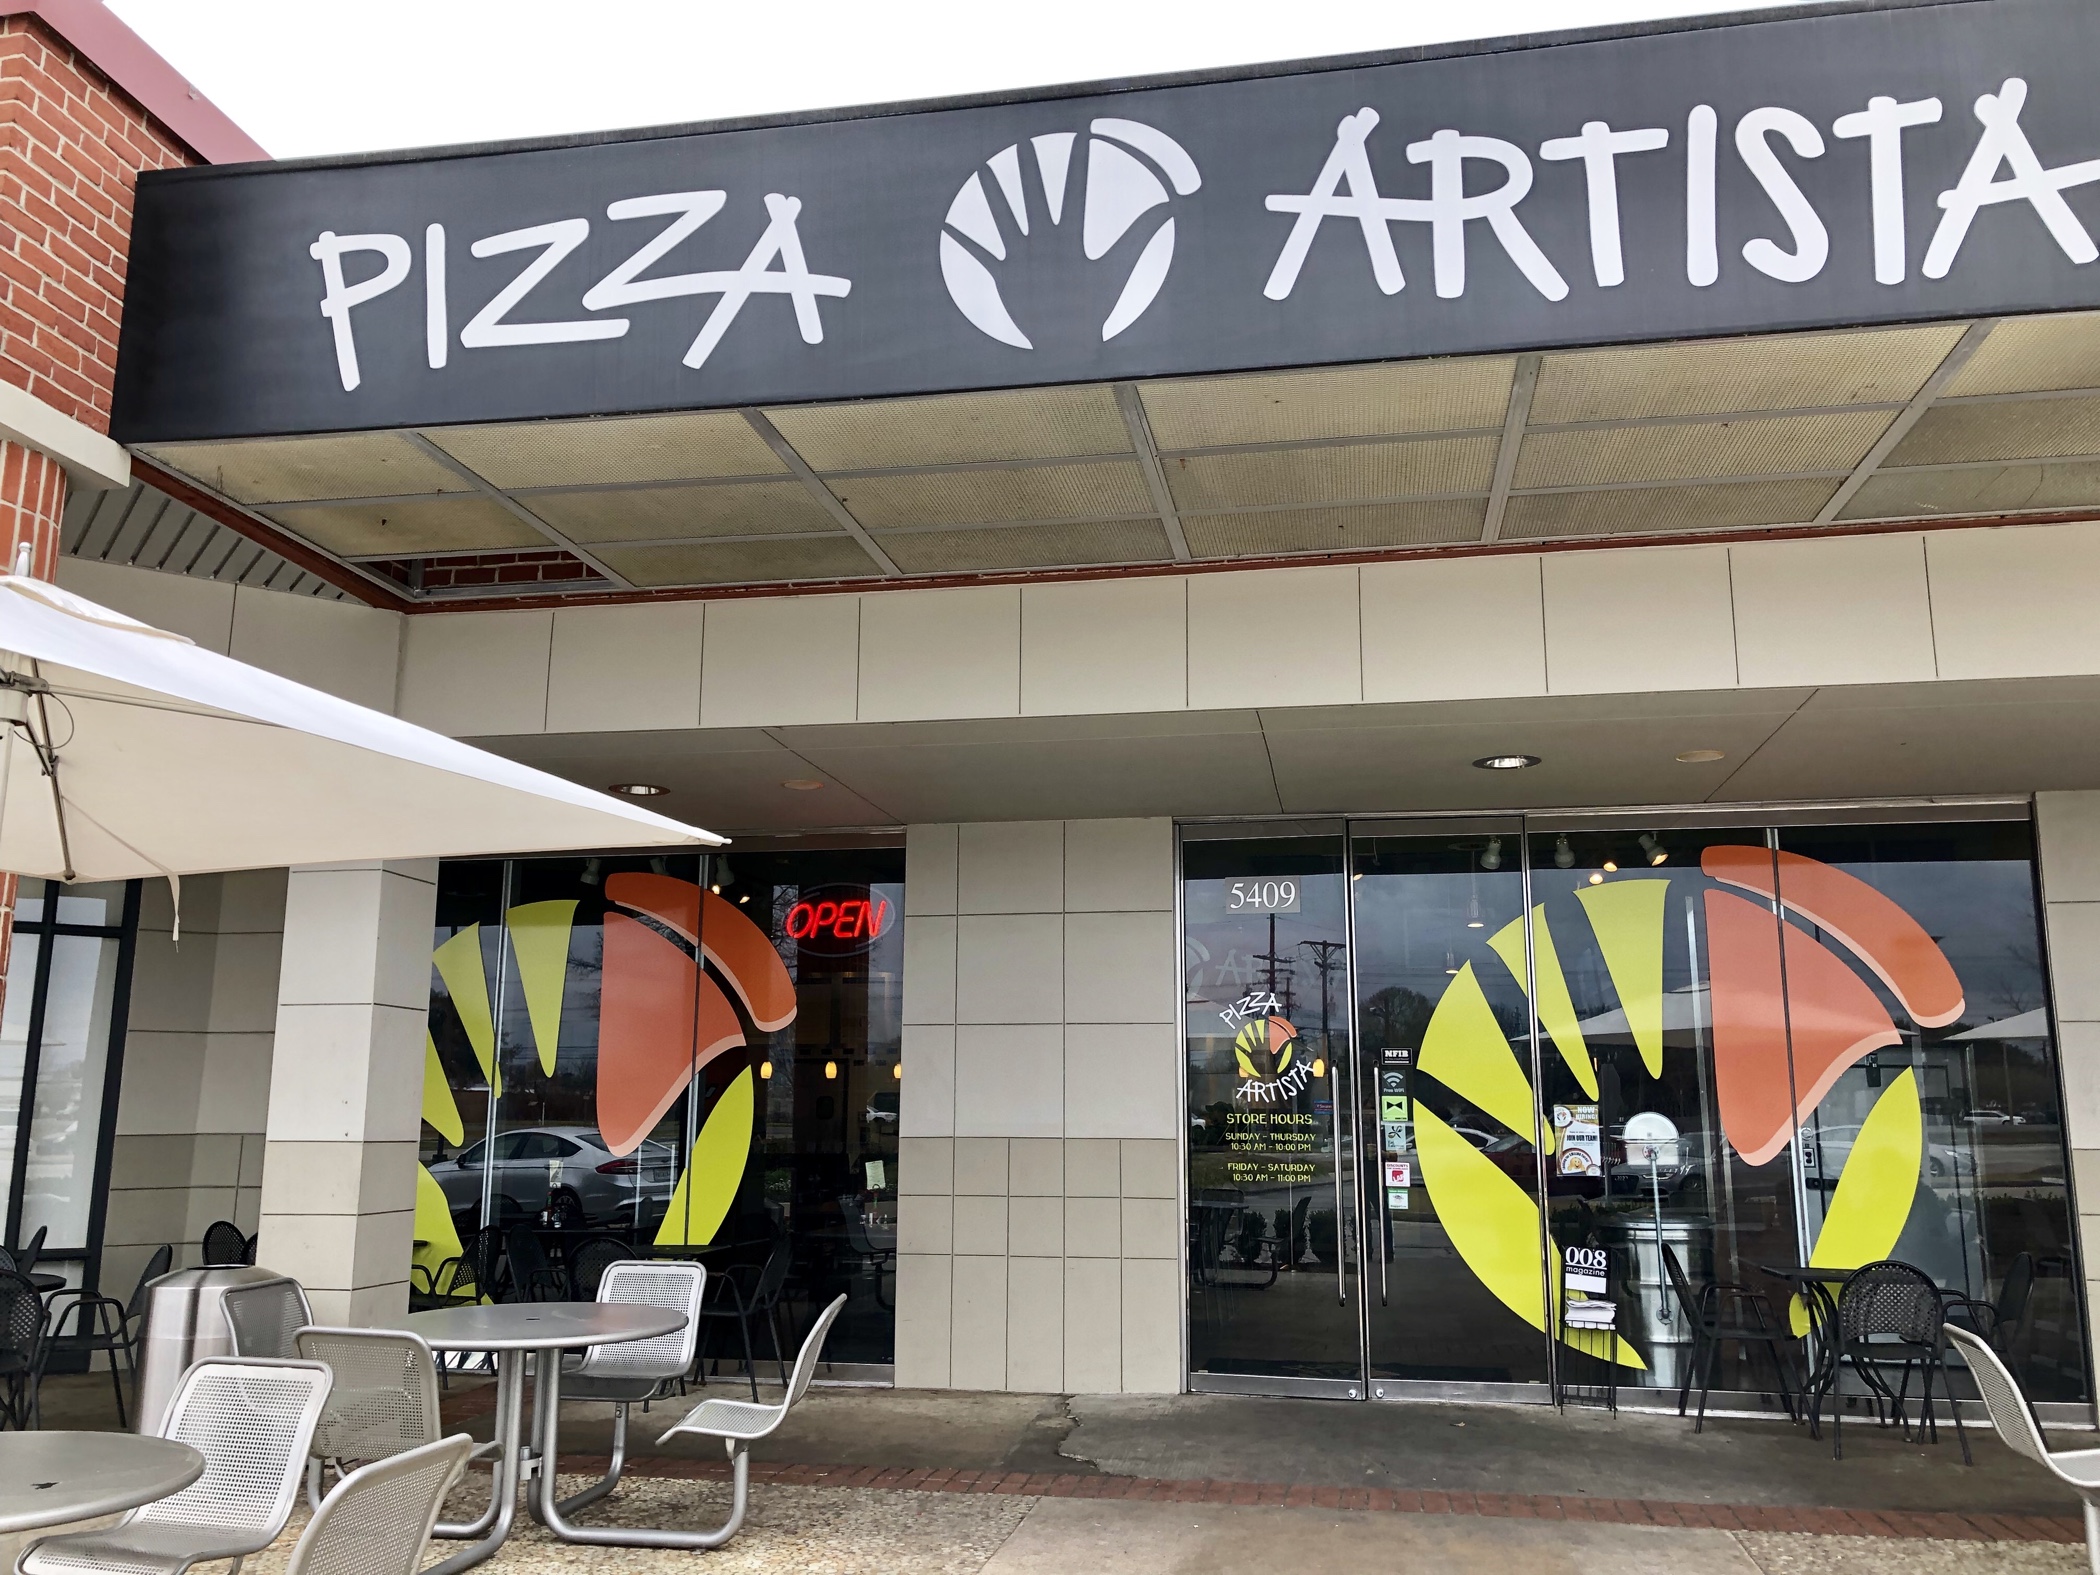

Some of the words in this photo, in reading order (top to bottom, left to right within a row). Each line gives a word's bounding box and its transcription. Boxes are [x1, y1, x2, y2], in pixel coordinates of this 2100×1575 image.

[309, 189, 852, 392] PIZZA
[1263, 77, 2100, 302] ARTISTA
[1230, 881, 1296, 909] 5409
[786, 900, 887, 938] OPEN
[1219, 991, 1282, 1030] PIZZA
[1384, 1050, 1409, 1058] NFIB
[1235, 1060, 1314, 1103] ARTISTA
[1577, 1106, 1595, 1114] NOW
[1226, 1113, 1268, 1125] STORE
[1270, 1113, 1313, 1125] HOURS
[1225, 1132, 1261, 1140] SUNDAY
[1269, 1133, 1317, 1141] THURSDAY
[1231, 1142, 1252, 1151] 10:30
[1253, 1143, 1267, 1151] AM
[1275, 1143, 1296, 1151] 10:00
[1297, 1143, 1312, 1151] PM
[1227, 1162, 1259, 1171] FRIDAY
[1267, 1163, 1316, 1172] SATURDAY
[1233, 1173, 1254, 1181] 10:30
[1255, 1173, 1269, 1182] AM
[1277, 1174, 1296, 1182] 11:00
[1297, 1174, 1311, 1182] PM
[1565, 1246, 1607, 1269] 008
[1565, 1266, 1606, 1277] magazine
